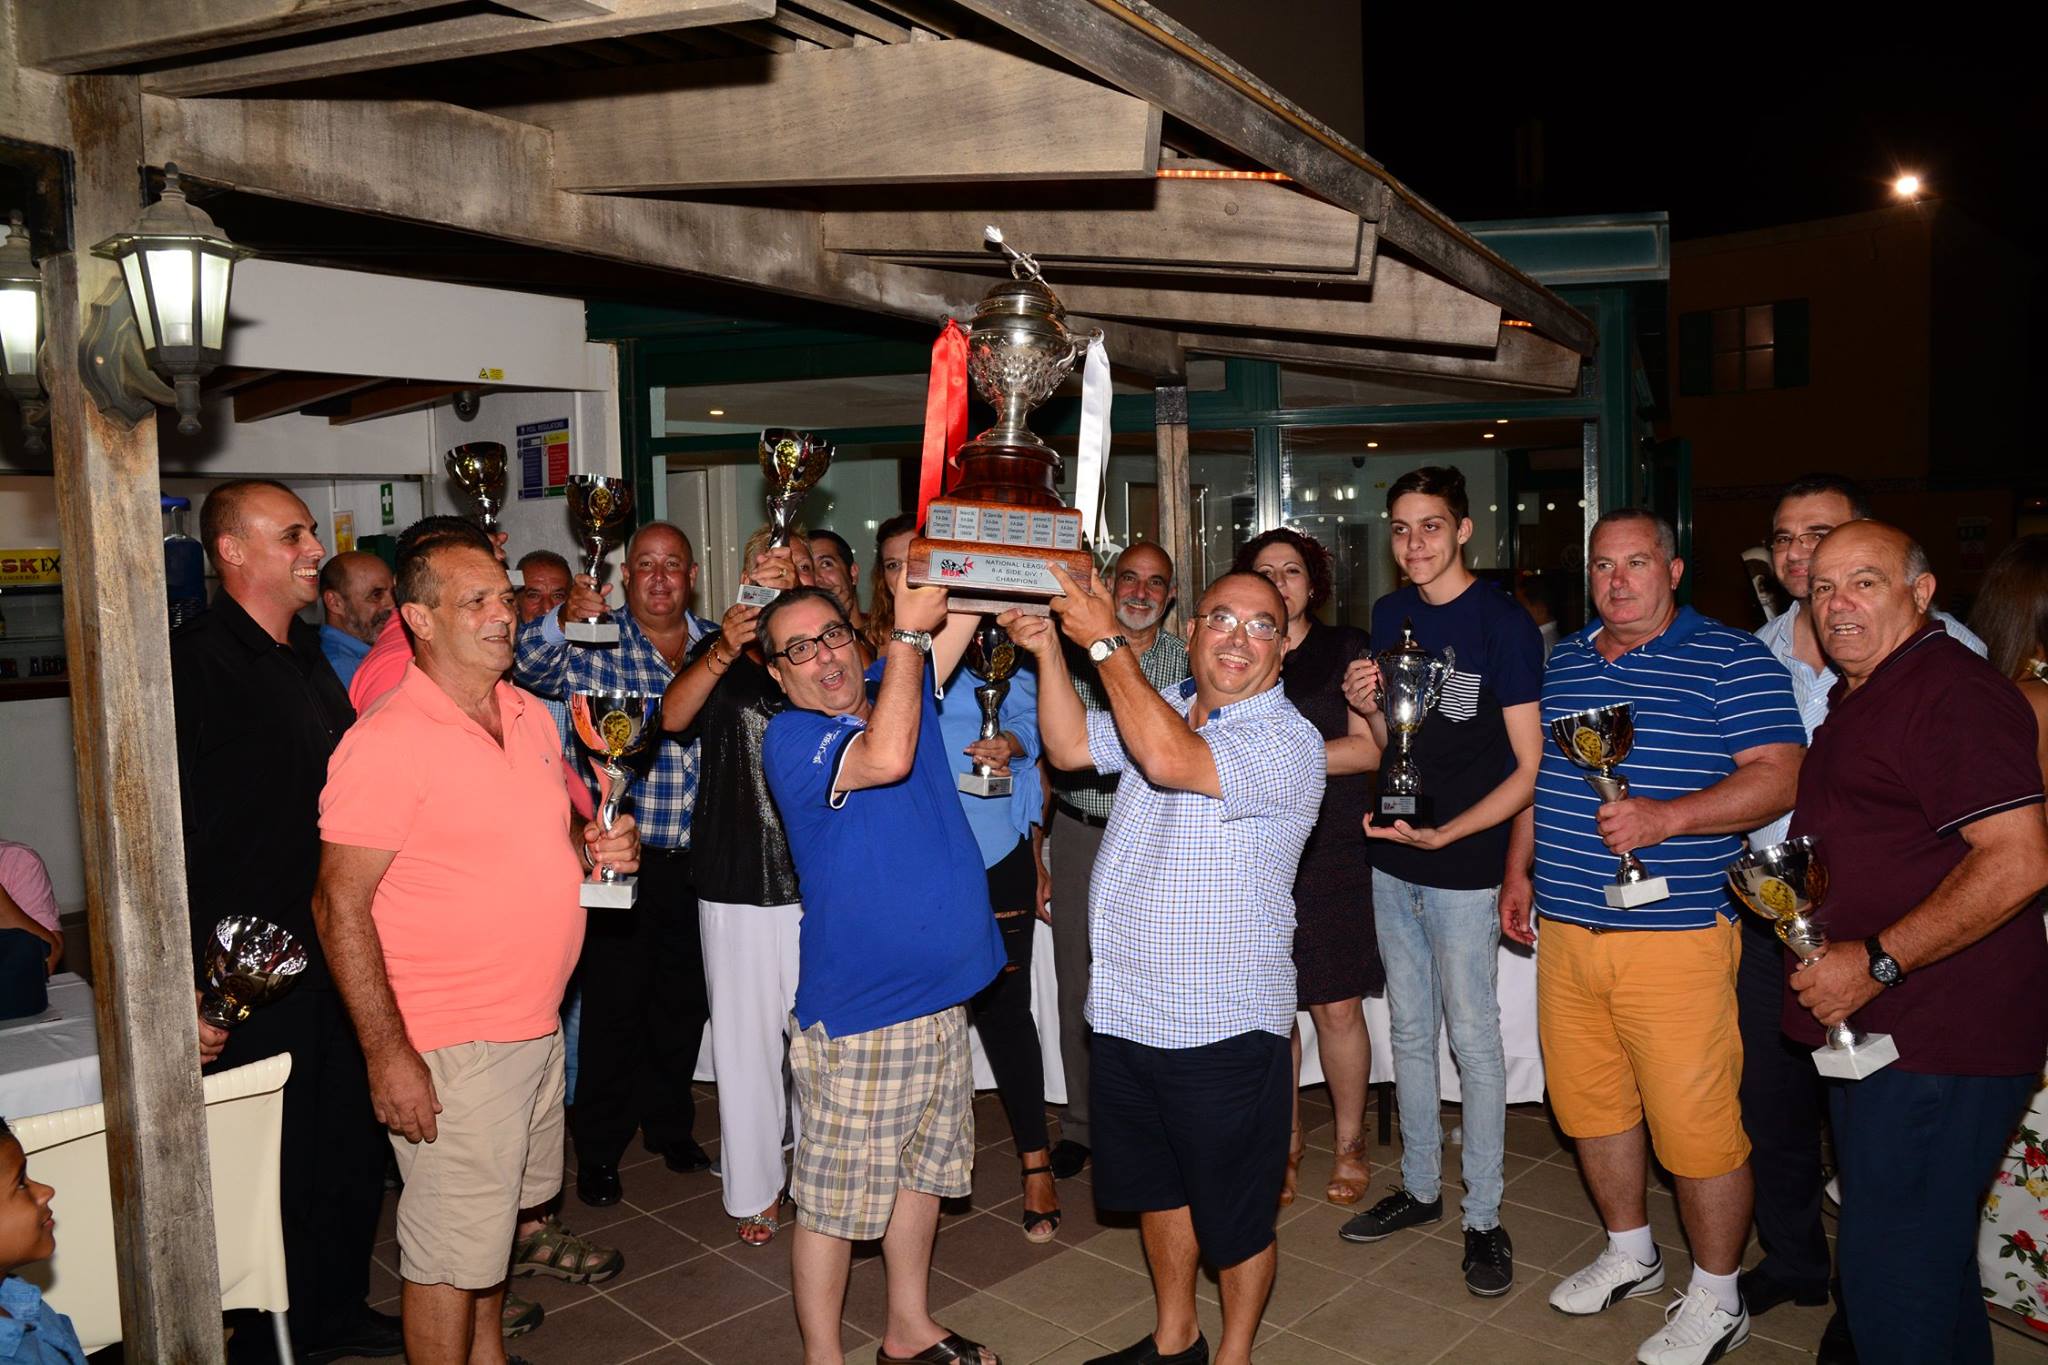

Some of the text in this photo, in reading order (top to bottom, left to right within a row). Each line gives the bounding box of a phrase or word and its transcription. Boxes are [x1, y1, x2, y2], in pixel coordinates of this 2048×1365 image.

[985, 559, 1049, 570] NATIONAL LEAGU
[995, 575, 1038, 585] CHAMPIONS
